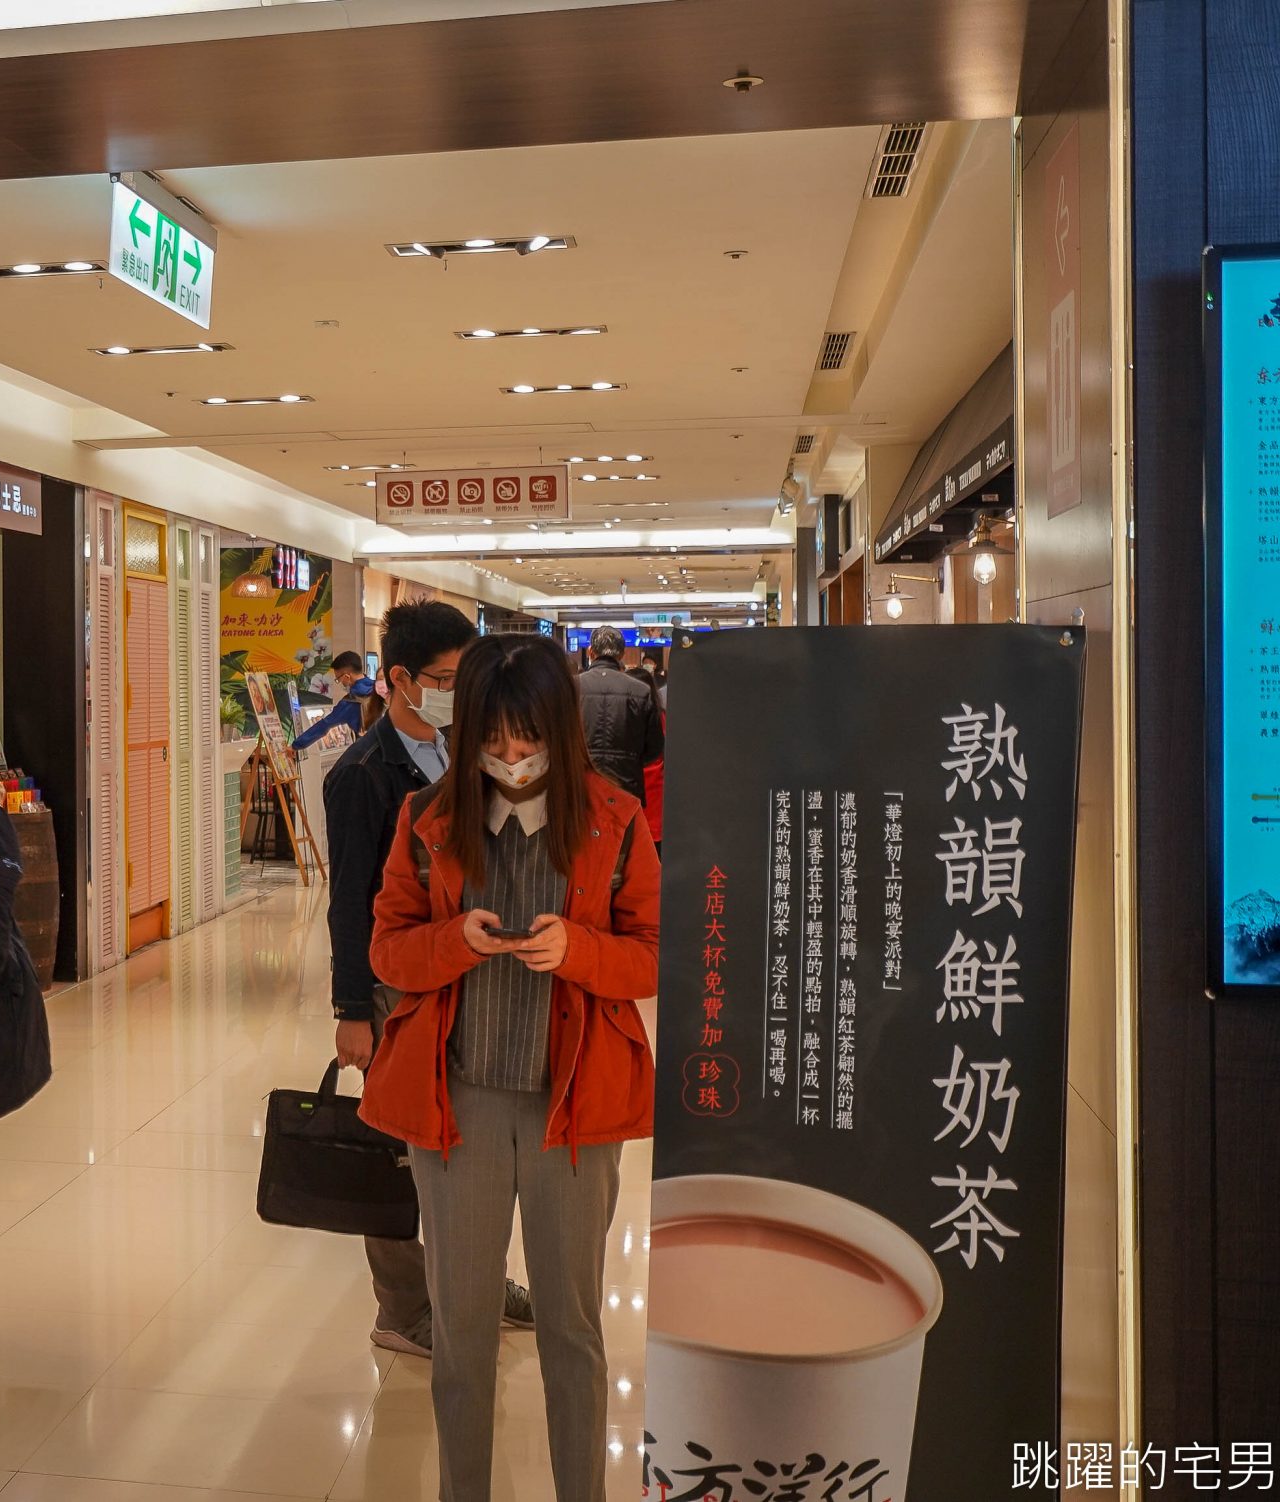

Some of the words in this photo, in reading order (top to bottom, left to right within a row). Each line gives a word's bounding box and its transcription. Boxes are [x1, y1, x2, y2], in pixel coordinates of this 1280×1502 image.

[179, 284, 201, 317] EXIT
[221, 629, 256, 637] KATONG
[258, 628, 285, 637] LAKSA
[882, 791, 904, 991] 「華燈初上的晚宴派對」
[700, 864, 728, 1046] 全店大杯免費加
[931, 701, 1029, 1270] 熟韻鮮奶茶
[697, 1059, 723, 1110] 珍珠
